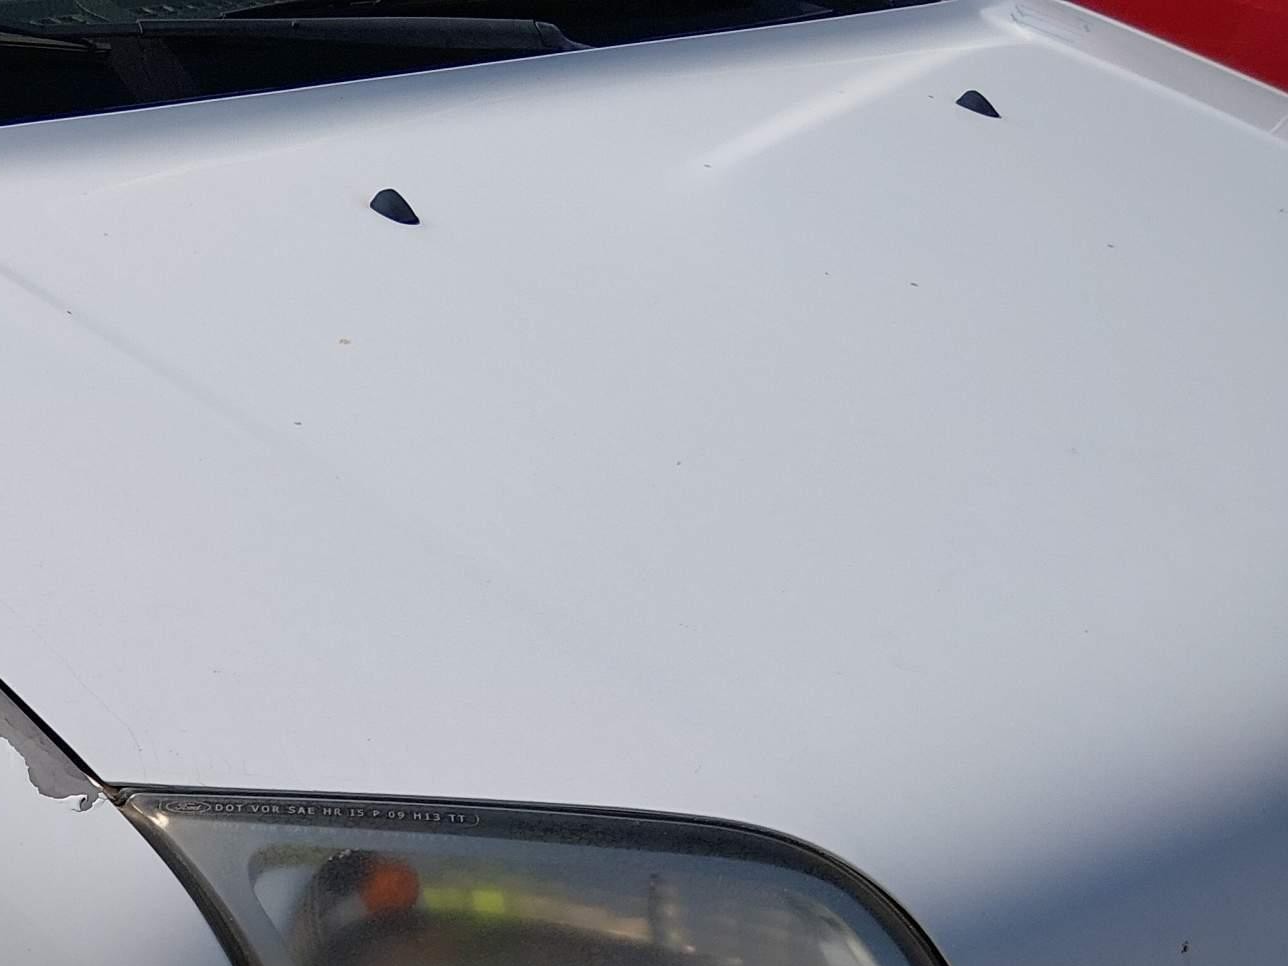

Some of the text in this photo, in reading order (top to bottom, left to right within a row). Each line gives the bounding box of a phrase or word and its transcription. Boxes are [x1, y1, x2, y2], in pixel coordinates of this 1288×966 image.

[215, 803, 244, 813] DOT
[251, 804, 280, 814] VOR
[288, 805, 315, 816] SAE
[323, 807, 343, 817] HR
[388, 810, 406, 820] 09
[414, 812, 442, 822] H13
